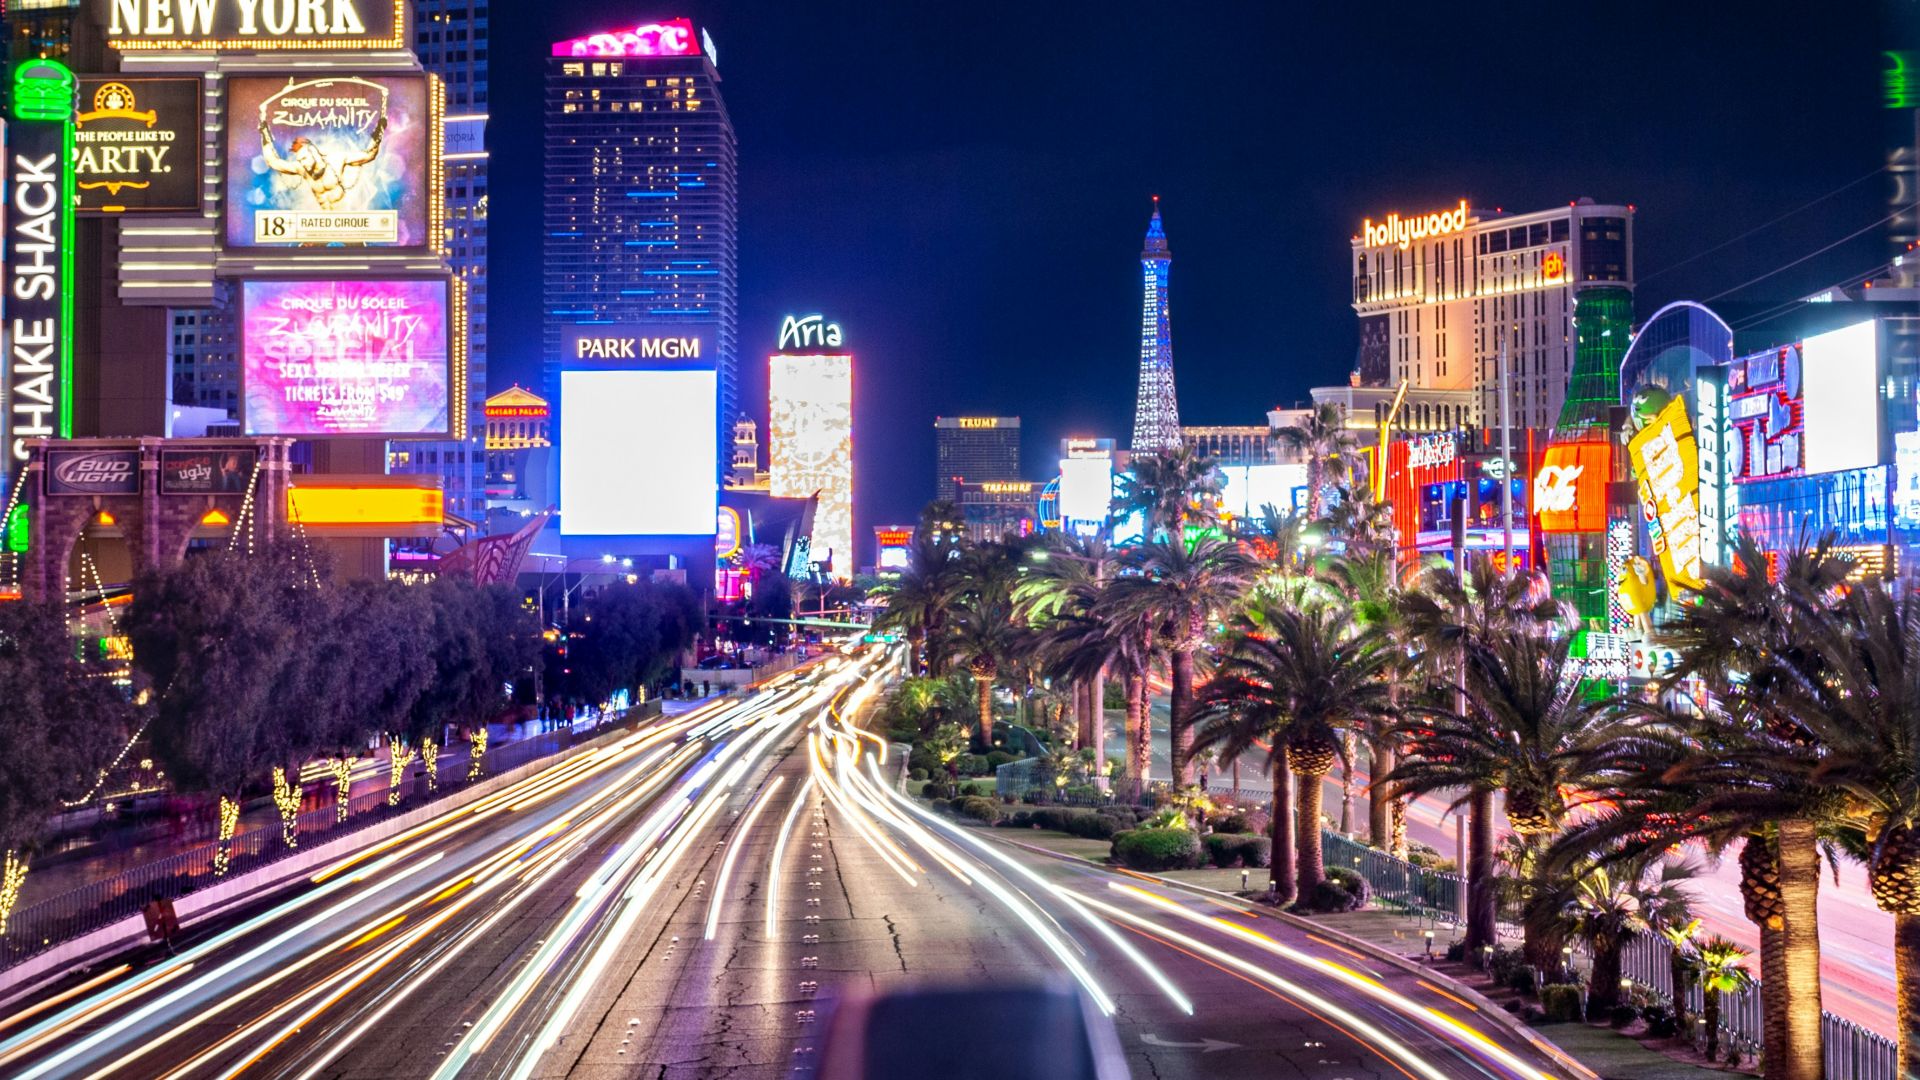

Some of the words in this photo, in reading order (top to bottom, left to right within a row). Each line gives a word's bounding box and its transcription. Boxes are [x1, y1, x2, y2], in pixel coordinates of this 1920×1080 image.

[108, 0, 219, 35] NEW
[238, 0, 367, 35] YORK
[280, 98, 318, 109] CIRQUE
[319, 98, 334, 107] DU
[335, 98, 370, 107] SOLEIL
[96, 131, 134, 141] PEOPLE
[135, 131, 158, 141] LIKE
[158, 130, 175, 141] TO
[15, 153, 56, 300] SHACK
[301, 218, 332, 228] RATED
[334, 218, 369, 229] CIRQUE
[1364, 200, 1467, 250] hollywood
[280, 298, 334, 313] CIRQUE
[336, 298, 359, 310] DU
[361, 298, 409, 310] SOLEIL
[778, 314, 843, 350] Aria
[577, 338, 635, 359] PARK
[641, 338, 701, 359] MGM
[284, 384, 336, 402] TICKETS
[339, 384, 377, 401] FROM
[959, 417, 998, 428] TRUMP
[77, 460, 131, 472] BUD
[178, 464, 213, 480] ugly
[1697, 377, 1719, 567] SKECHERS
[64, 471, 134, 483] LIGHT
[982, 482, 1032, 493] TREASURE
